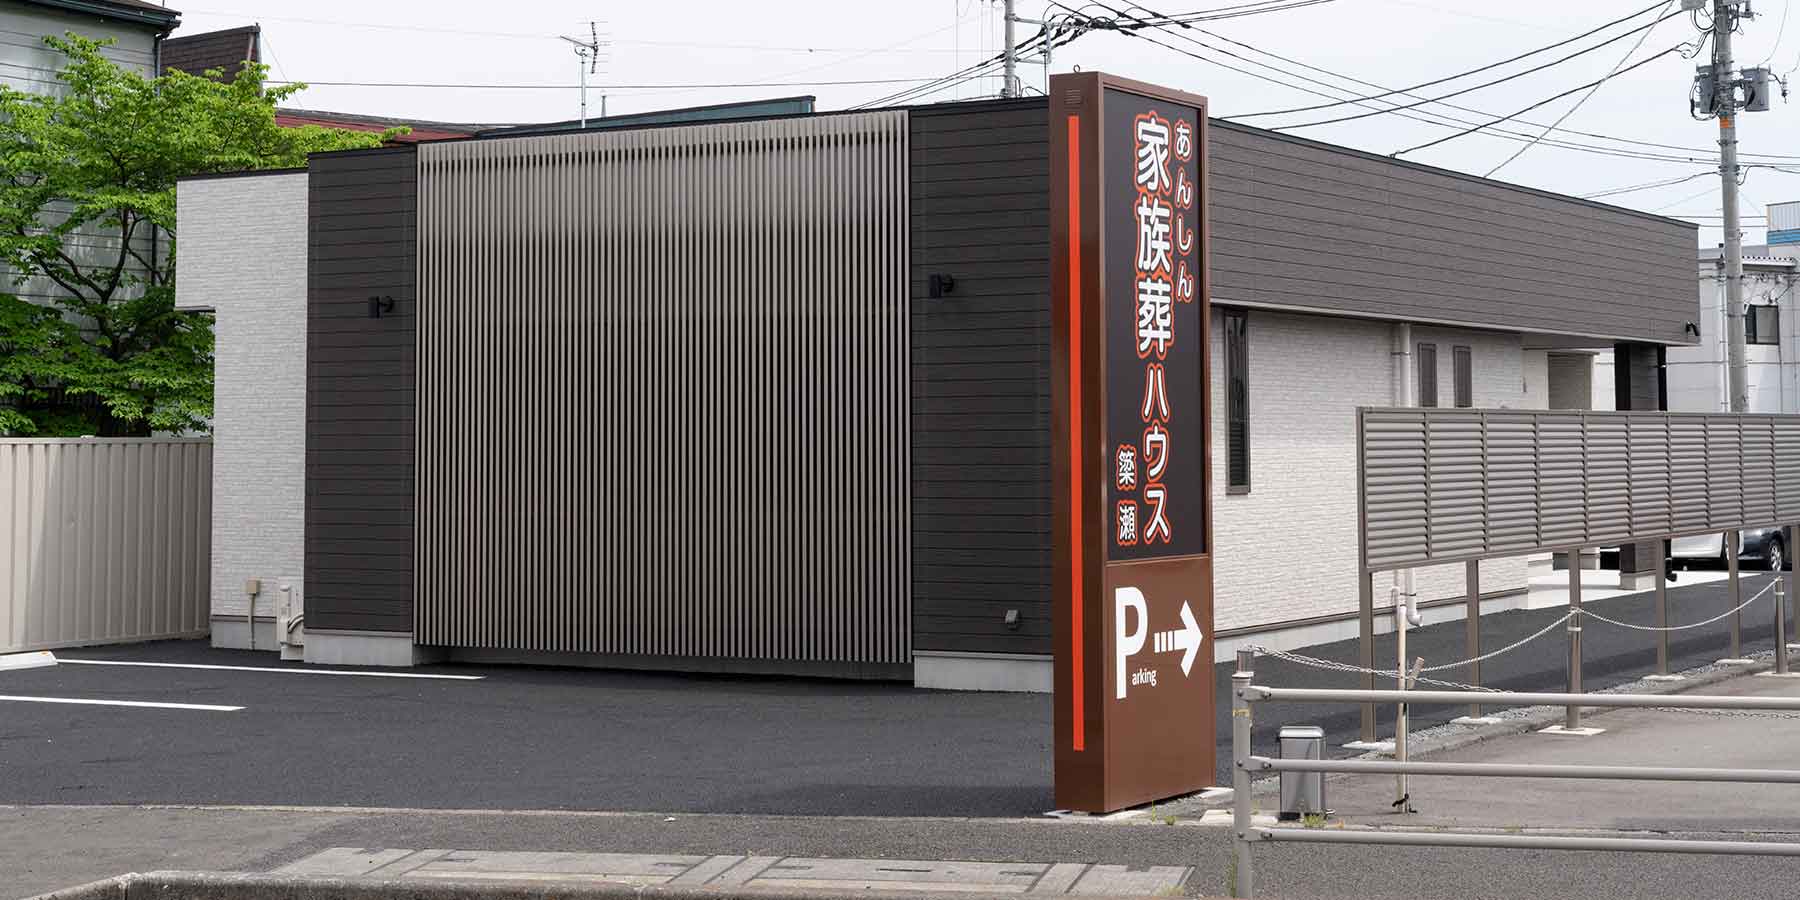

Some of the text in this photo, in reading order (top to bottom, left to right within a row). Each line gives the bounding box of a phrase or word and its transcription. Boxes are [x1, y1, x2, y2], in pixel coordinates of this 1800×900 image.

[1135, 114, 1172, 541] 家族葬ハウス
[1175, 121, 1193, 300] あんしん
